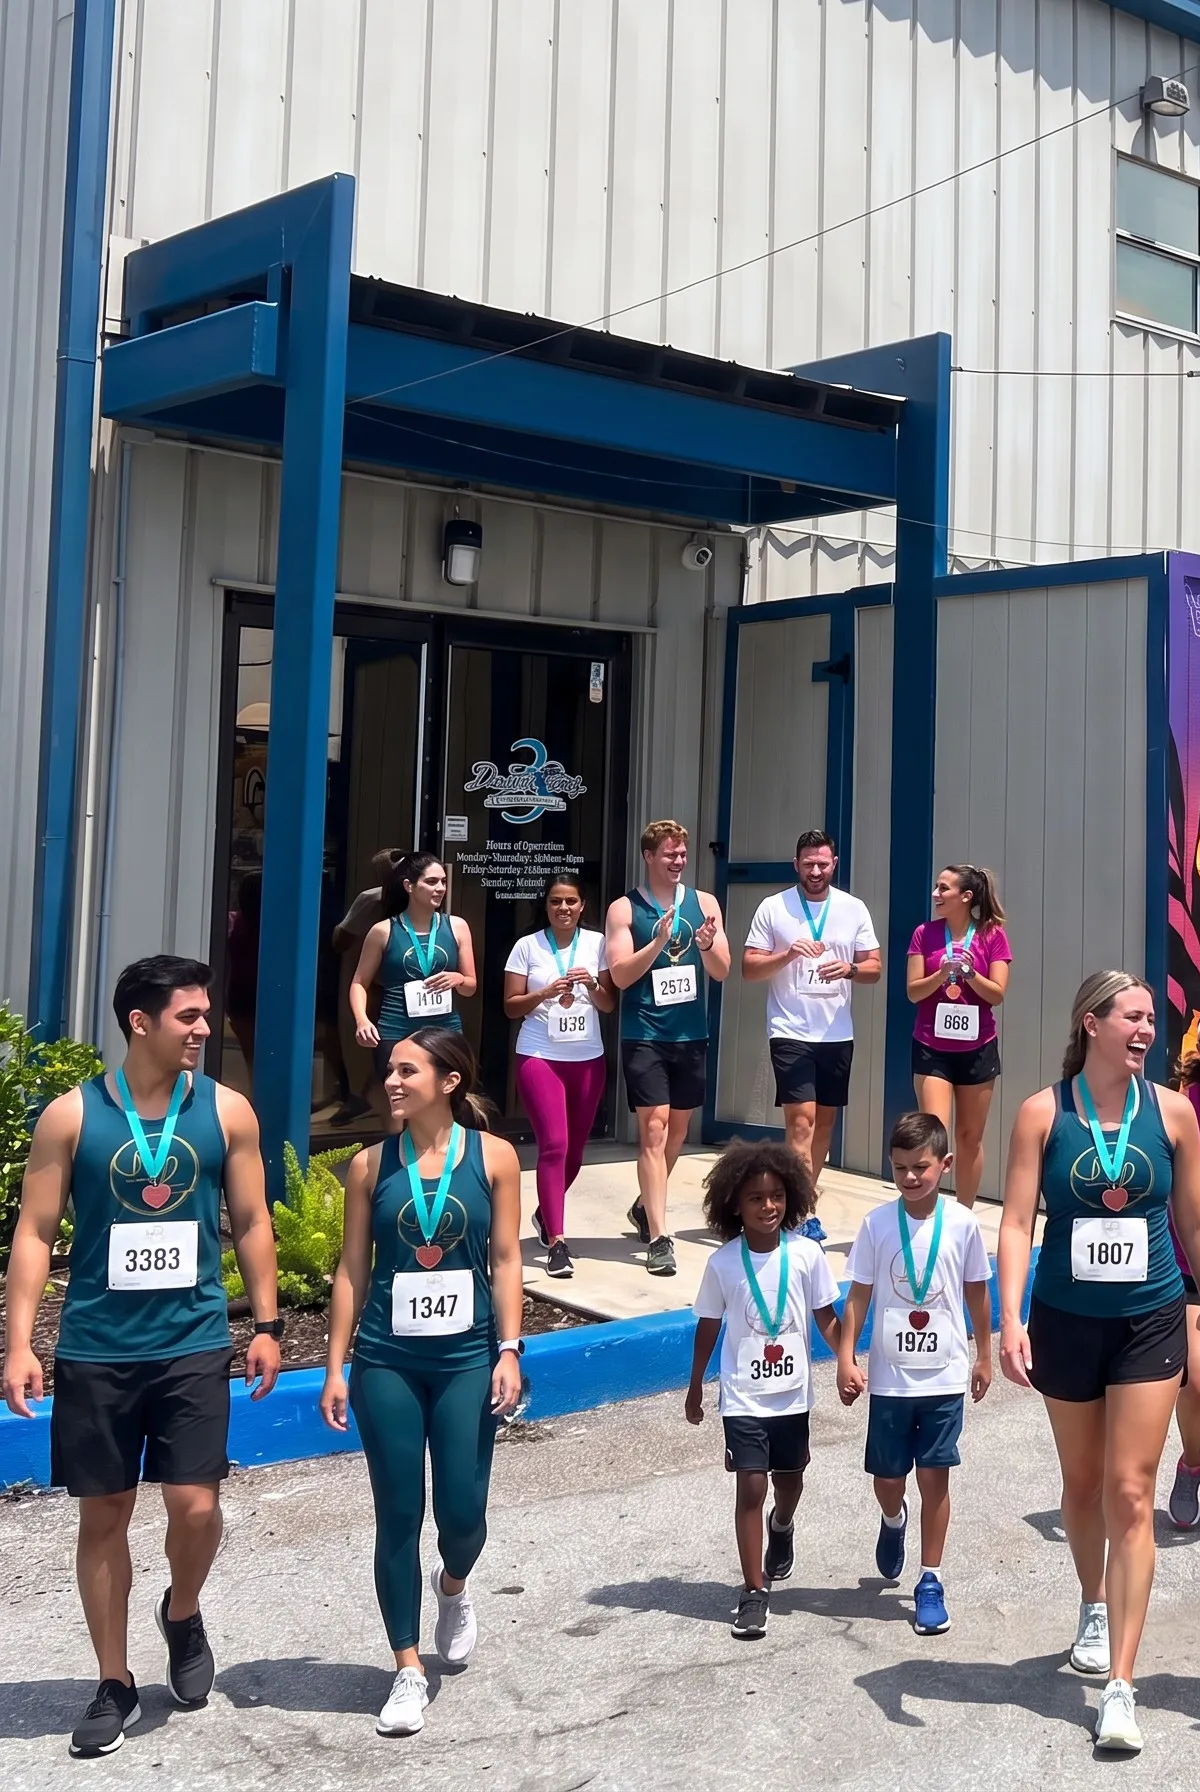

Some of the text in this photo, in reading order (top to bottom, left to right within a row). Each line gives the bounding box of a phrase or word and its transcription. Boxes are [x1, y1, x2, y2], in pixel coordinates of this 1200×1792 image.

[485, 840, 512, 850] Hours
[513, 840, 522, 851] of
[660, 978, 692, 997] 2573
[944, 1014, 970, 1031] 668
[125, 1247, 180, 1272] 3383
[1087, 1242, 1134, 1266] 1807
[409, 1294, 458, 1320] 1347
[895, 1331, 938, 1353] 1973
